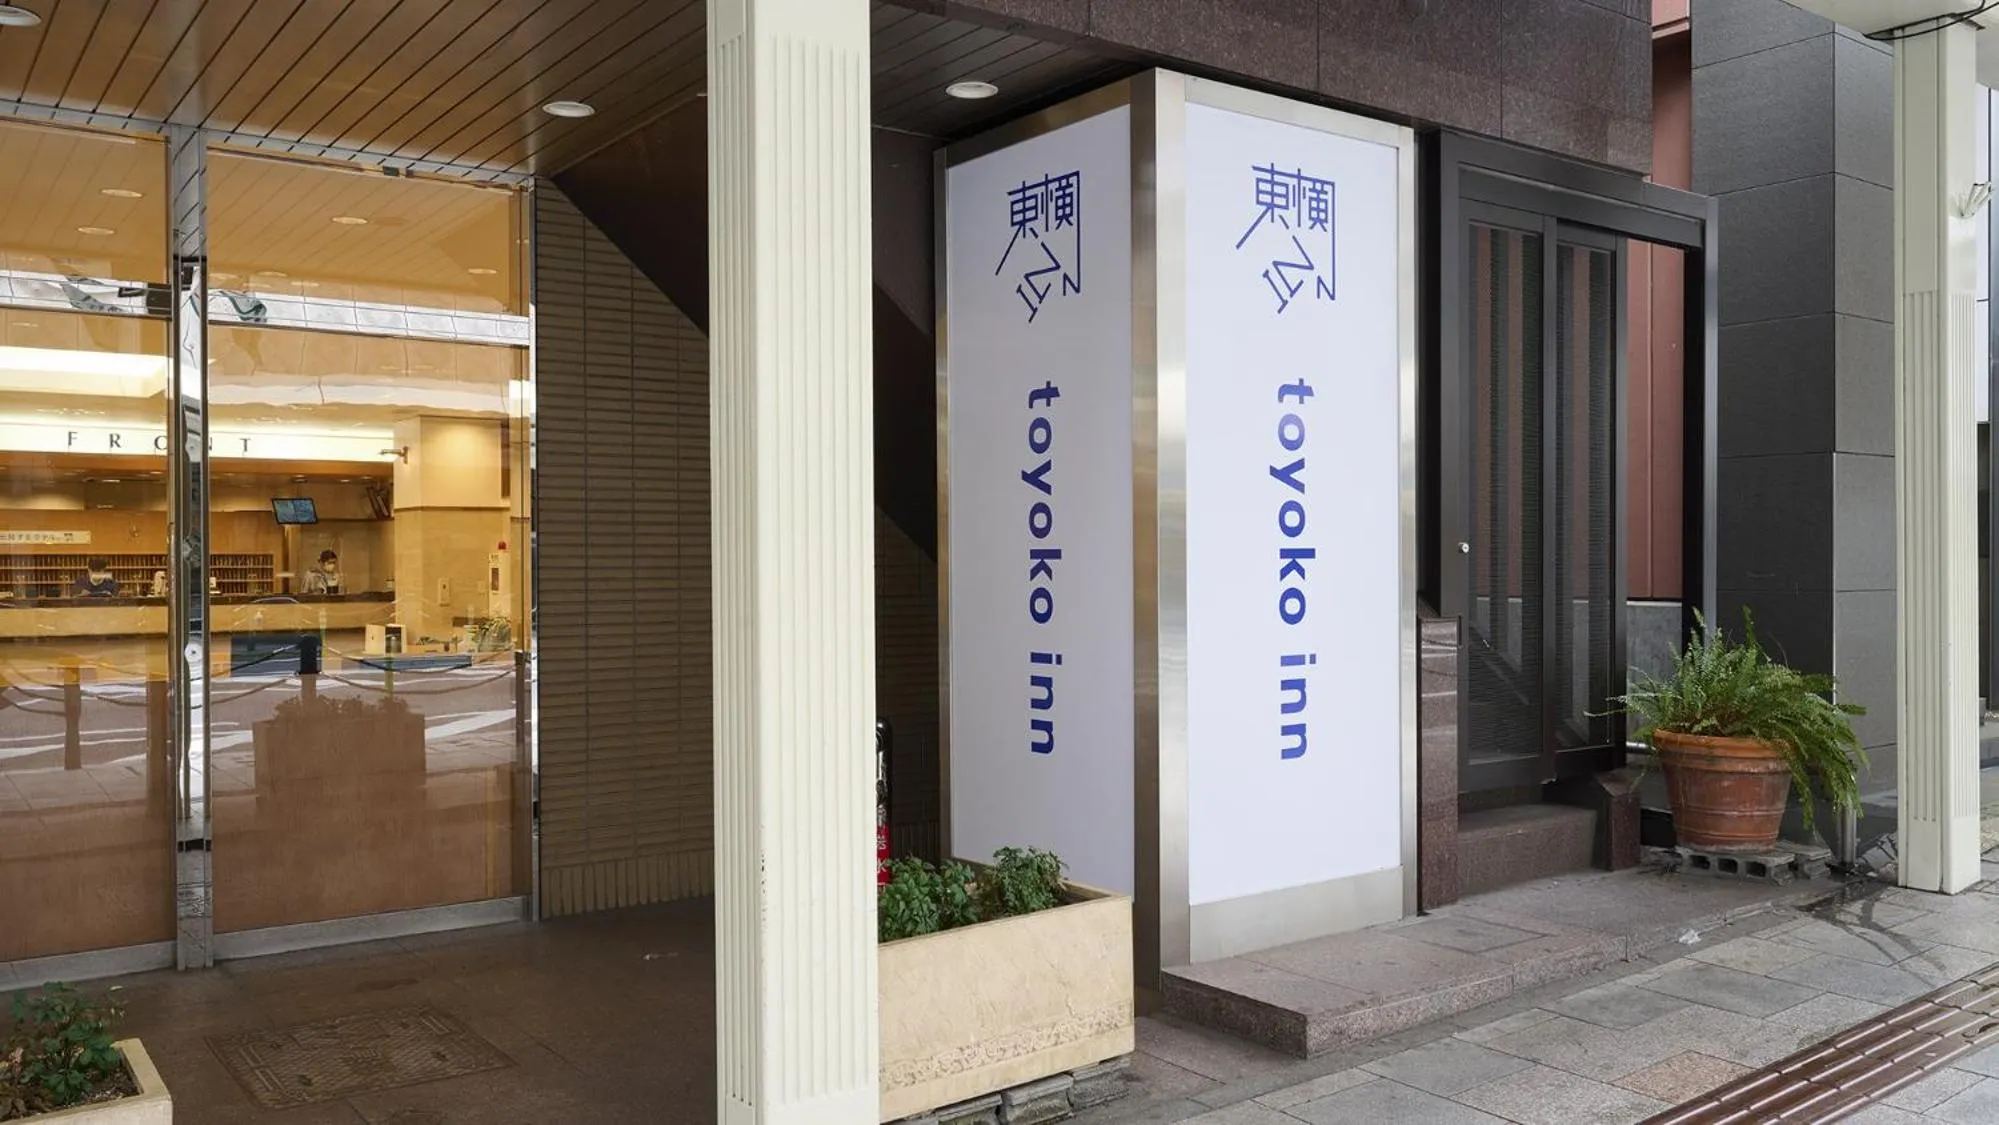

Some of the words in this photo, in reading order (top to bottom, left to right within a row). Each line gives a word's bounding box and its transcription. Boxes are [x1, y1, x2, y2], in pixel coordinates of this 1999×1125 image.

[68, 431, 251, 453] FROT
[1021, 380, 1062, 624] toyoko
[1270, 378, 1315, 625] toyoko
[1029, 652, 1062, 754] inn
[1281, 654, 1316, 760] inn
